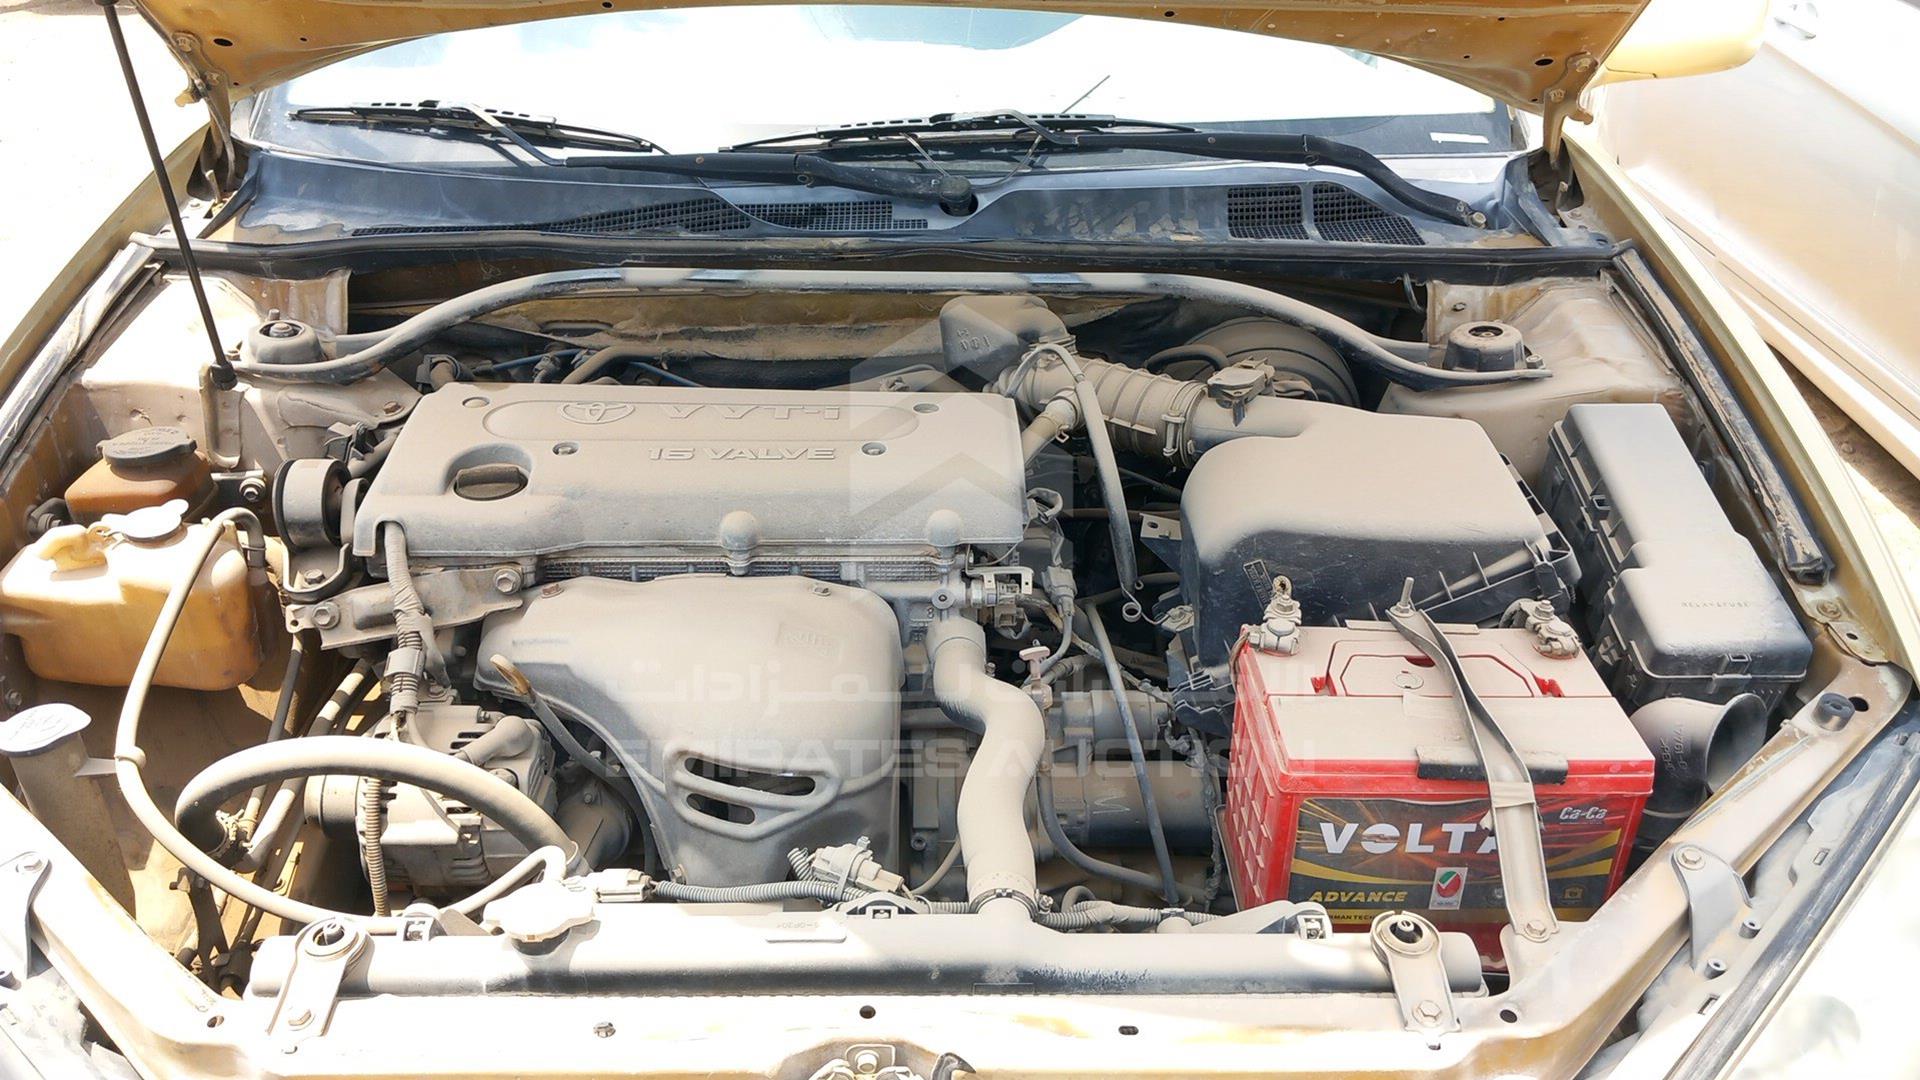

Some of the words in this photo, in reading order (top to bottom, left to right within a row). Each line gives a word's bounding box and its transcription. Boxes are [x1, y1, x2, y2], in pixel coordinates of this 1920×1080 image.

[650, 447, 696, 461] 16
[702, 447, 837, 461] VALVE
[1560, 806, 1608, 819] Ca-Ca
[1309, 891, 1409, 903] ADVANCE
